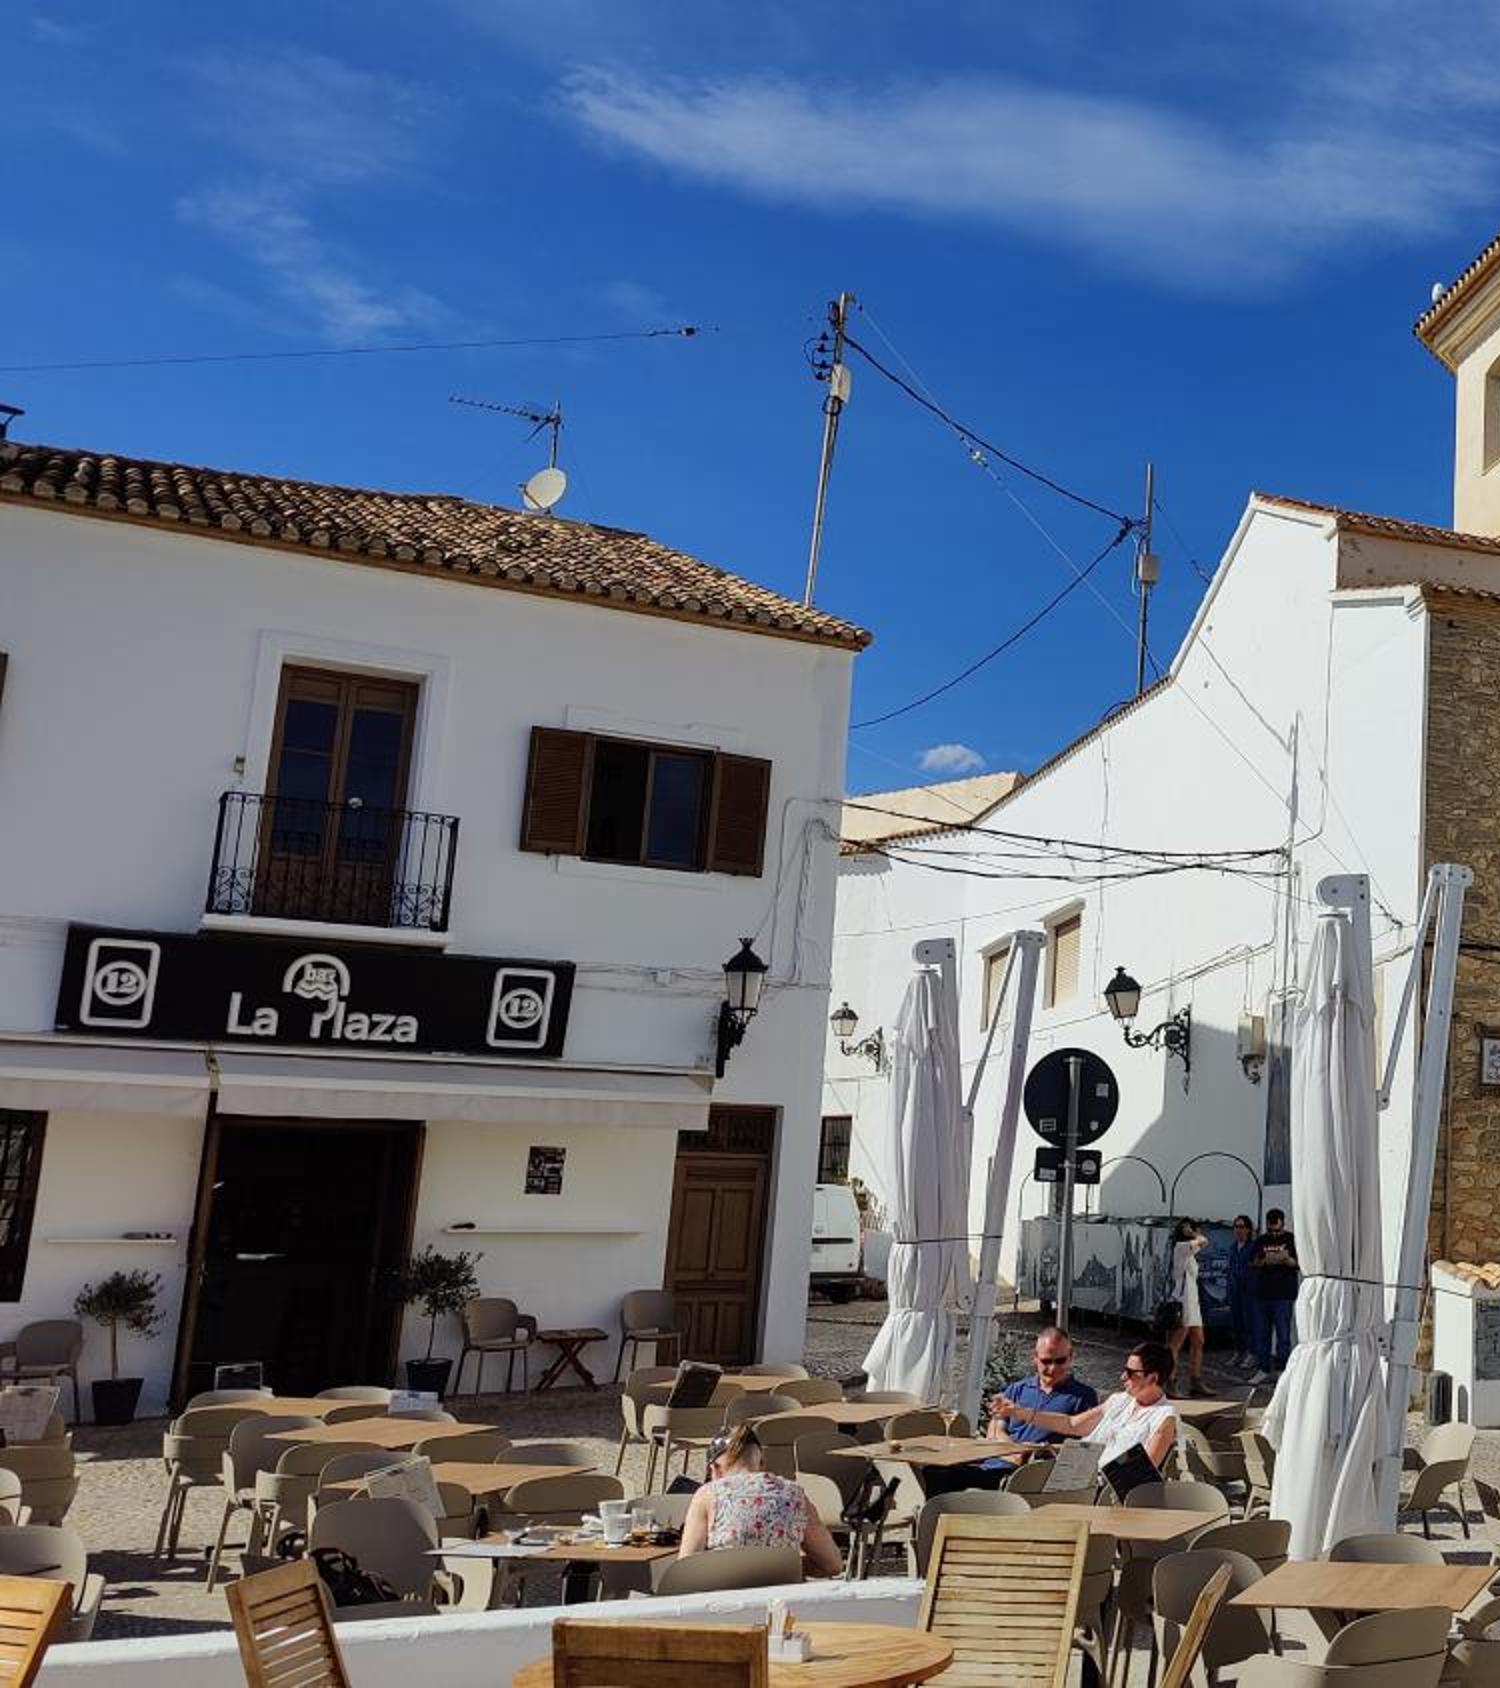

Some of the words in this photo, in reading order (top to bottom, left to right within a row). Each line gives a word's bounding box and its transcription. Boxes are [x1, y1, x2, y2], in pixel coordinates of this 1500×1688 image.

[103, 971, 137, 993] 12
[226, 991, 279, 1036] La
[507, 997, 538, 1017] 12
